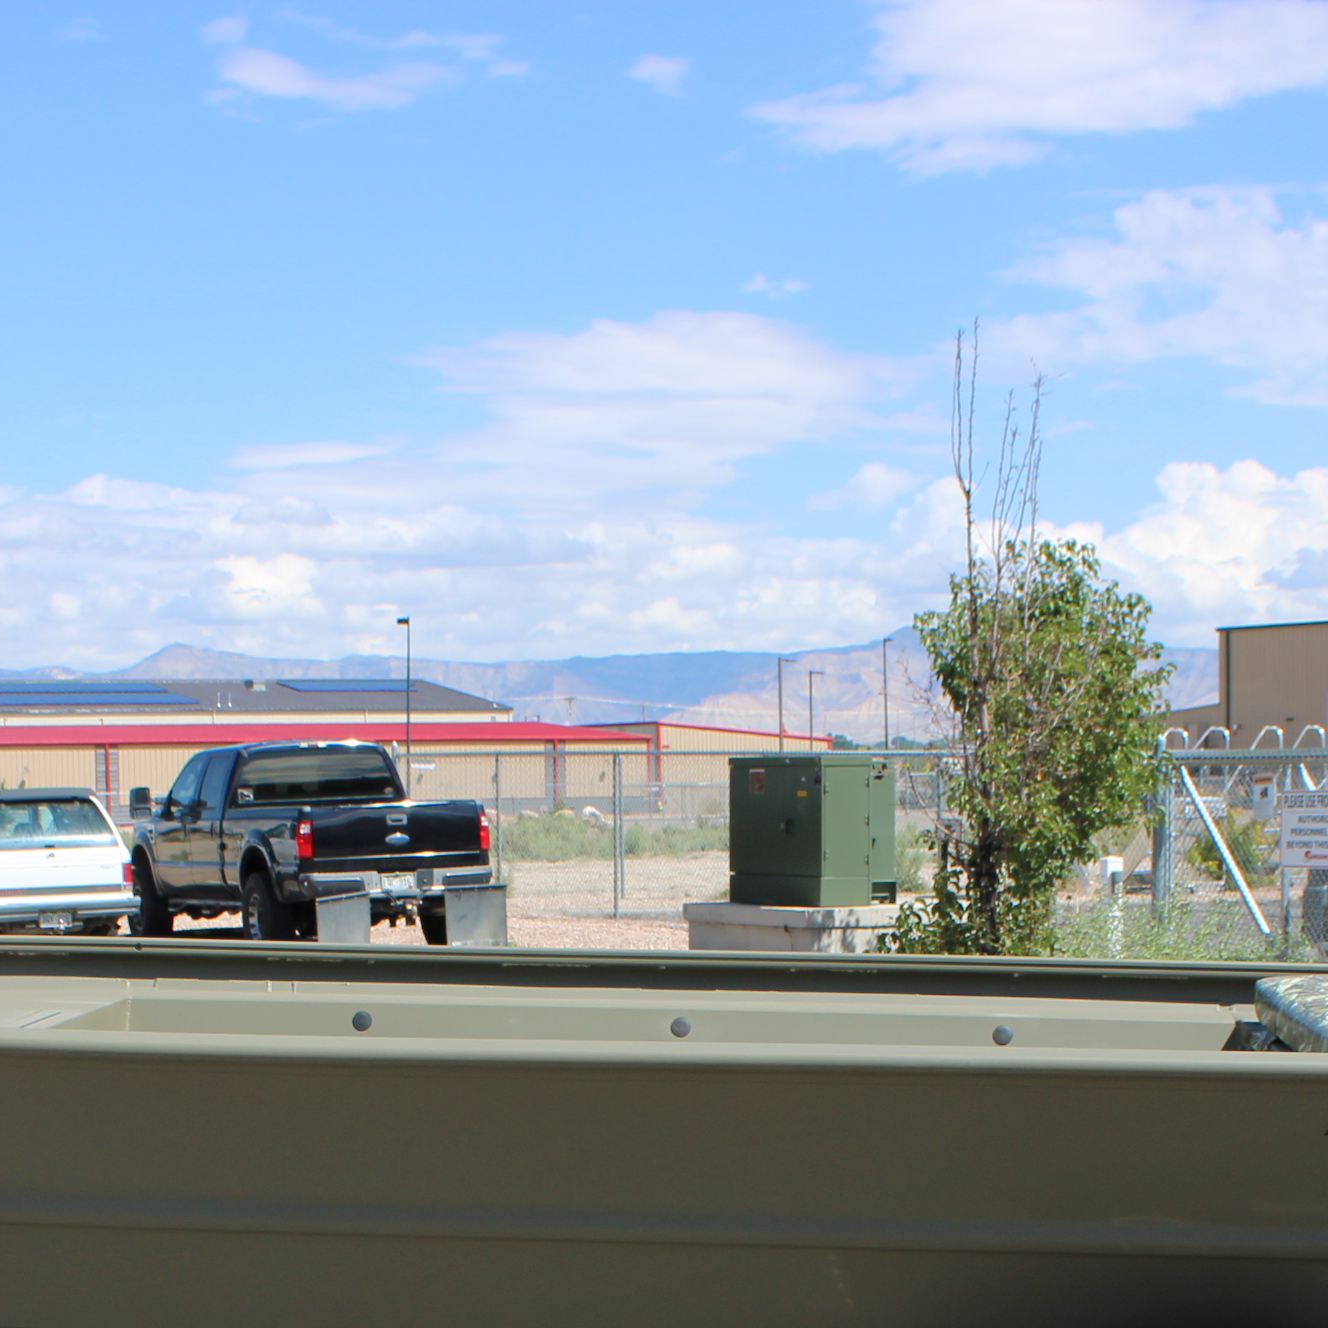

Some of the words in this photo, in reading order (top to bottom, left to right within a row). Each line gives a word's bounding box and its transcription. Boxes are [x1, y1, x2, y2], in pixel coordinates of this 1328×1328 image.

[1283, 793, 1304, 808] PLEASE
[1305, 793, 1316, 808] USE
[1290, 827, 1328, 836] PERSONNEL
[1286, 841, 1313, 849] BEYOND
[1314, 841, 1328, 849] THIS
